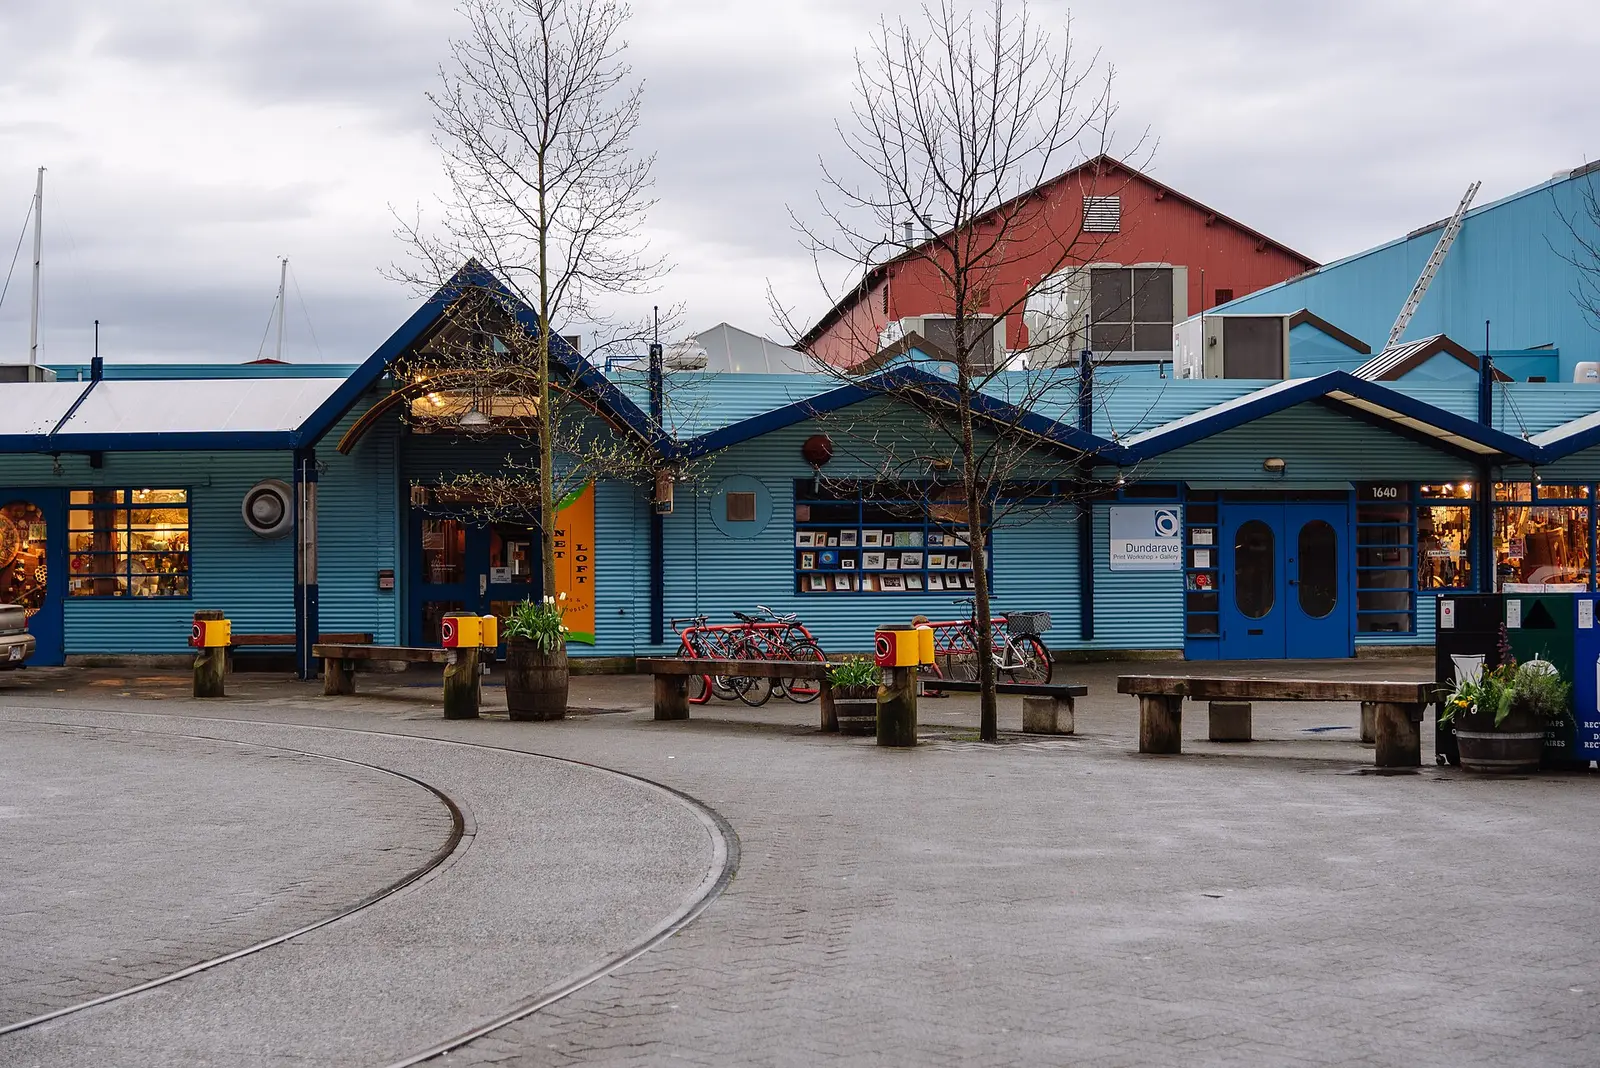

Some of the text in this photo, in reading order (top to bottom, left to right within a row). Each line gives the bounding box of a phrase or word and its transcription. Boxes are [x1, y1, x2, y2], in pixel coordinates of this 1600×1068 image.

[1372, 487, 1397, 498] 1640
[554, 530, 566, 558] NET
[1125, 543, 1179, 553] Dundarave
[575, 544, 588, 583] LOFT
